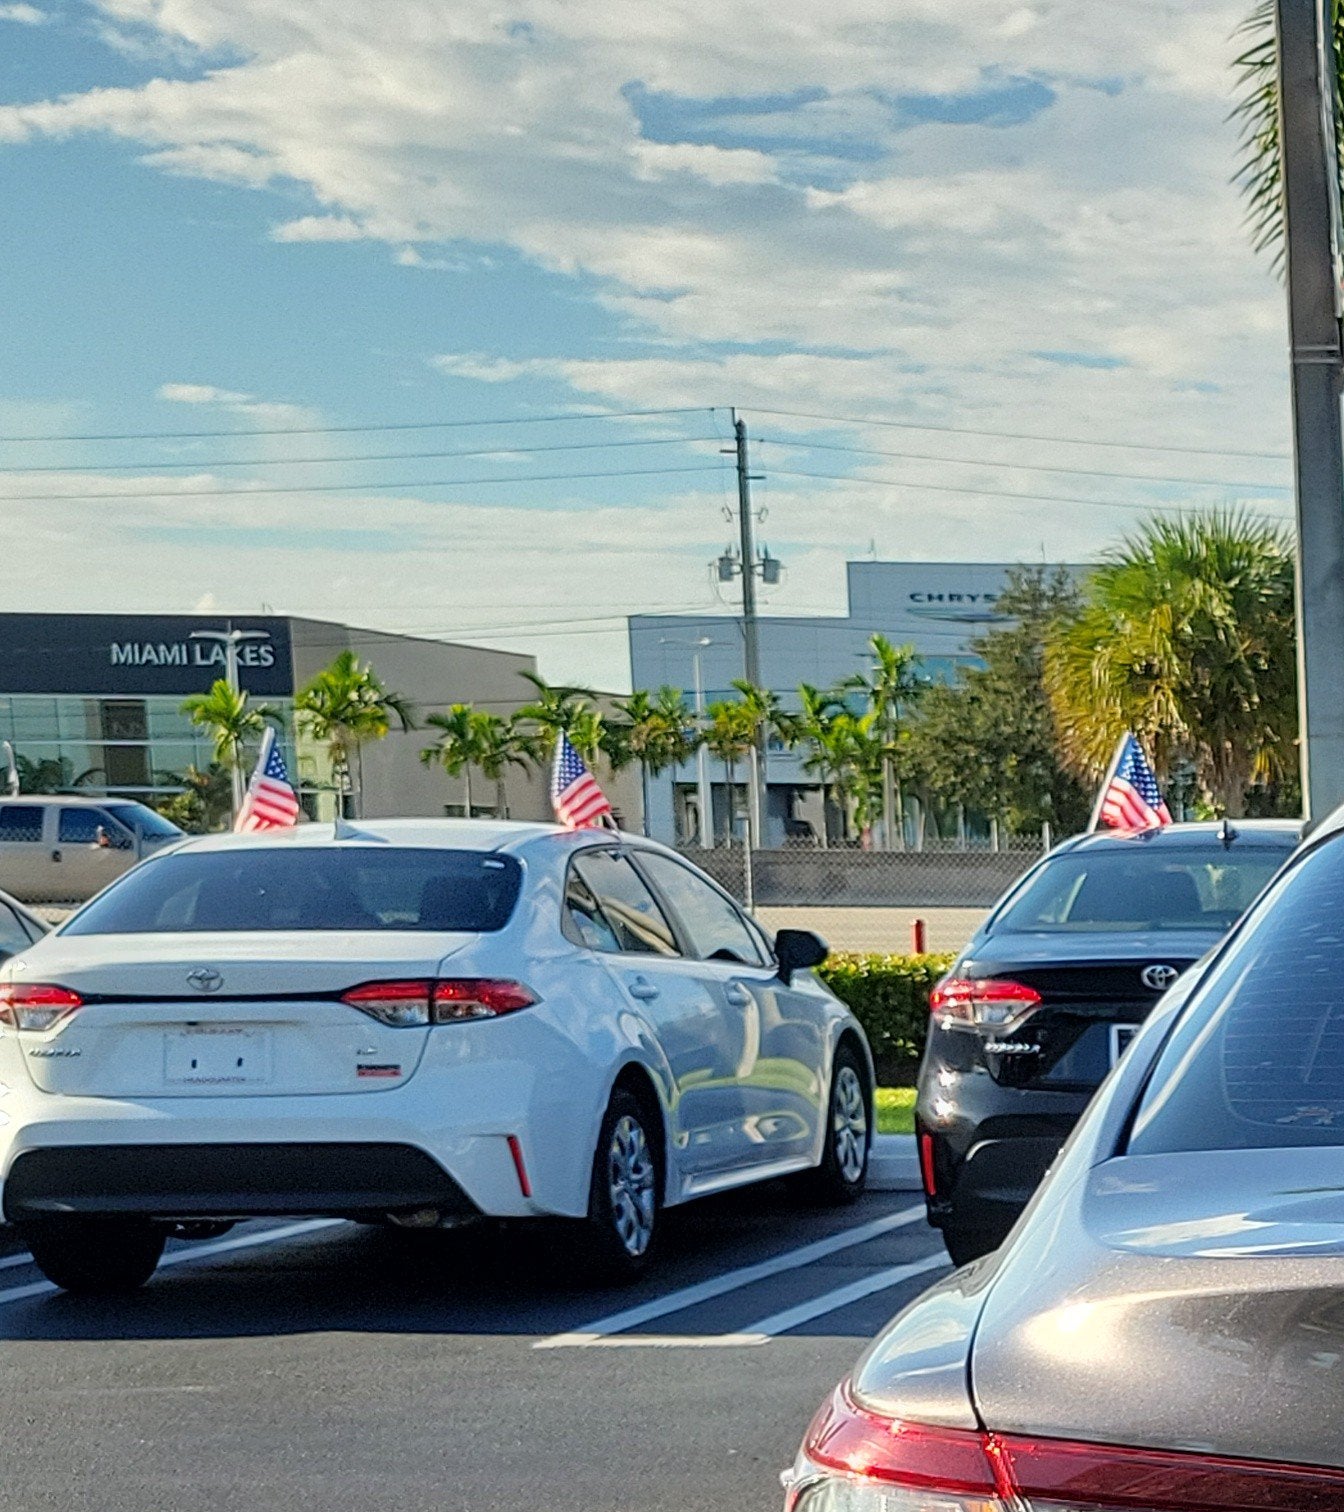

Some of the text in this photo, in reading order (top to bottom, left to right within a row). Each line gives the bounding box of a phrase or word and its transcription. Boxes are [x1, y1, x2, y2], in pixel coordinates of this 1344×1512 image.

[909, 592, 1001, 603] CHRYS
[111, 642, 275, 667] MIAMI LAKES
